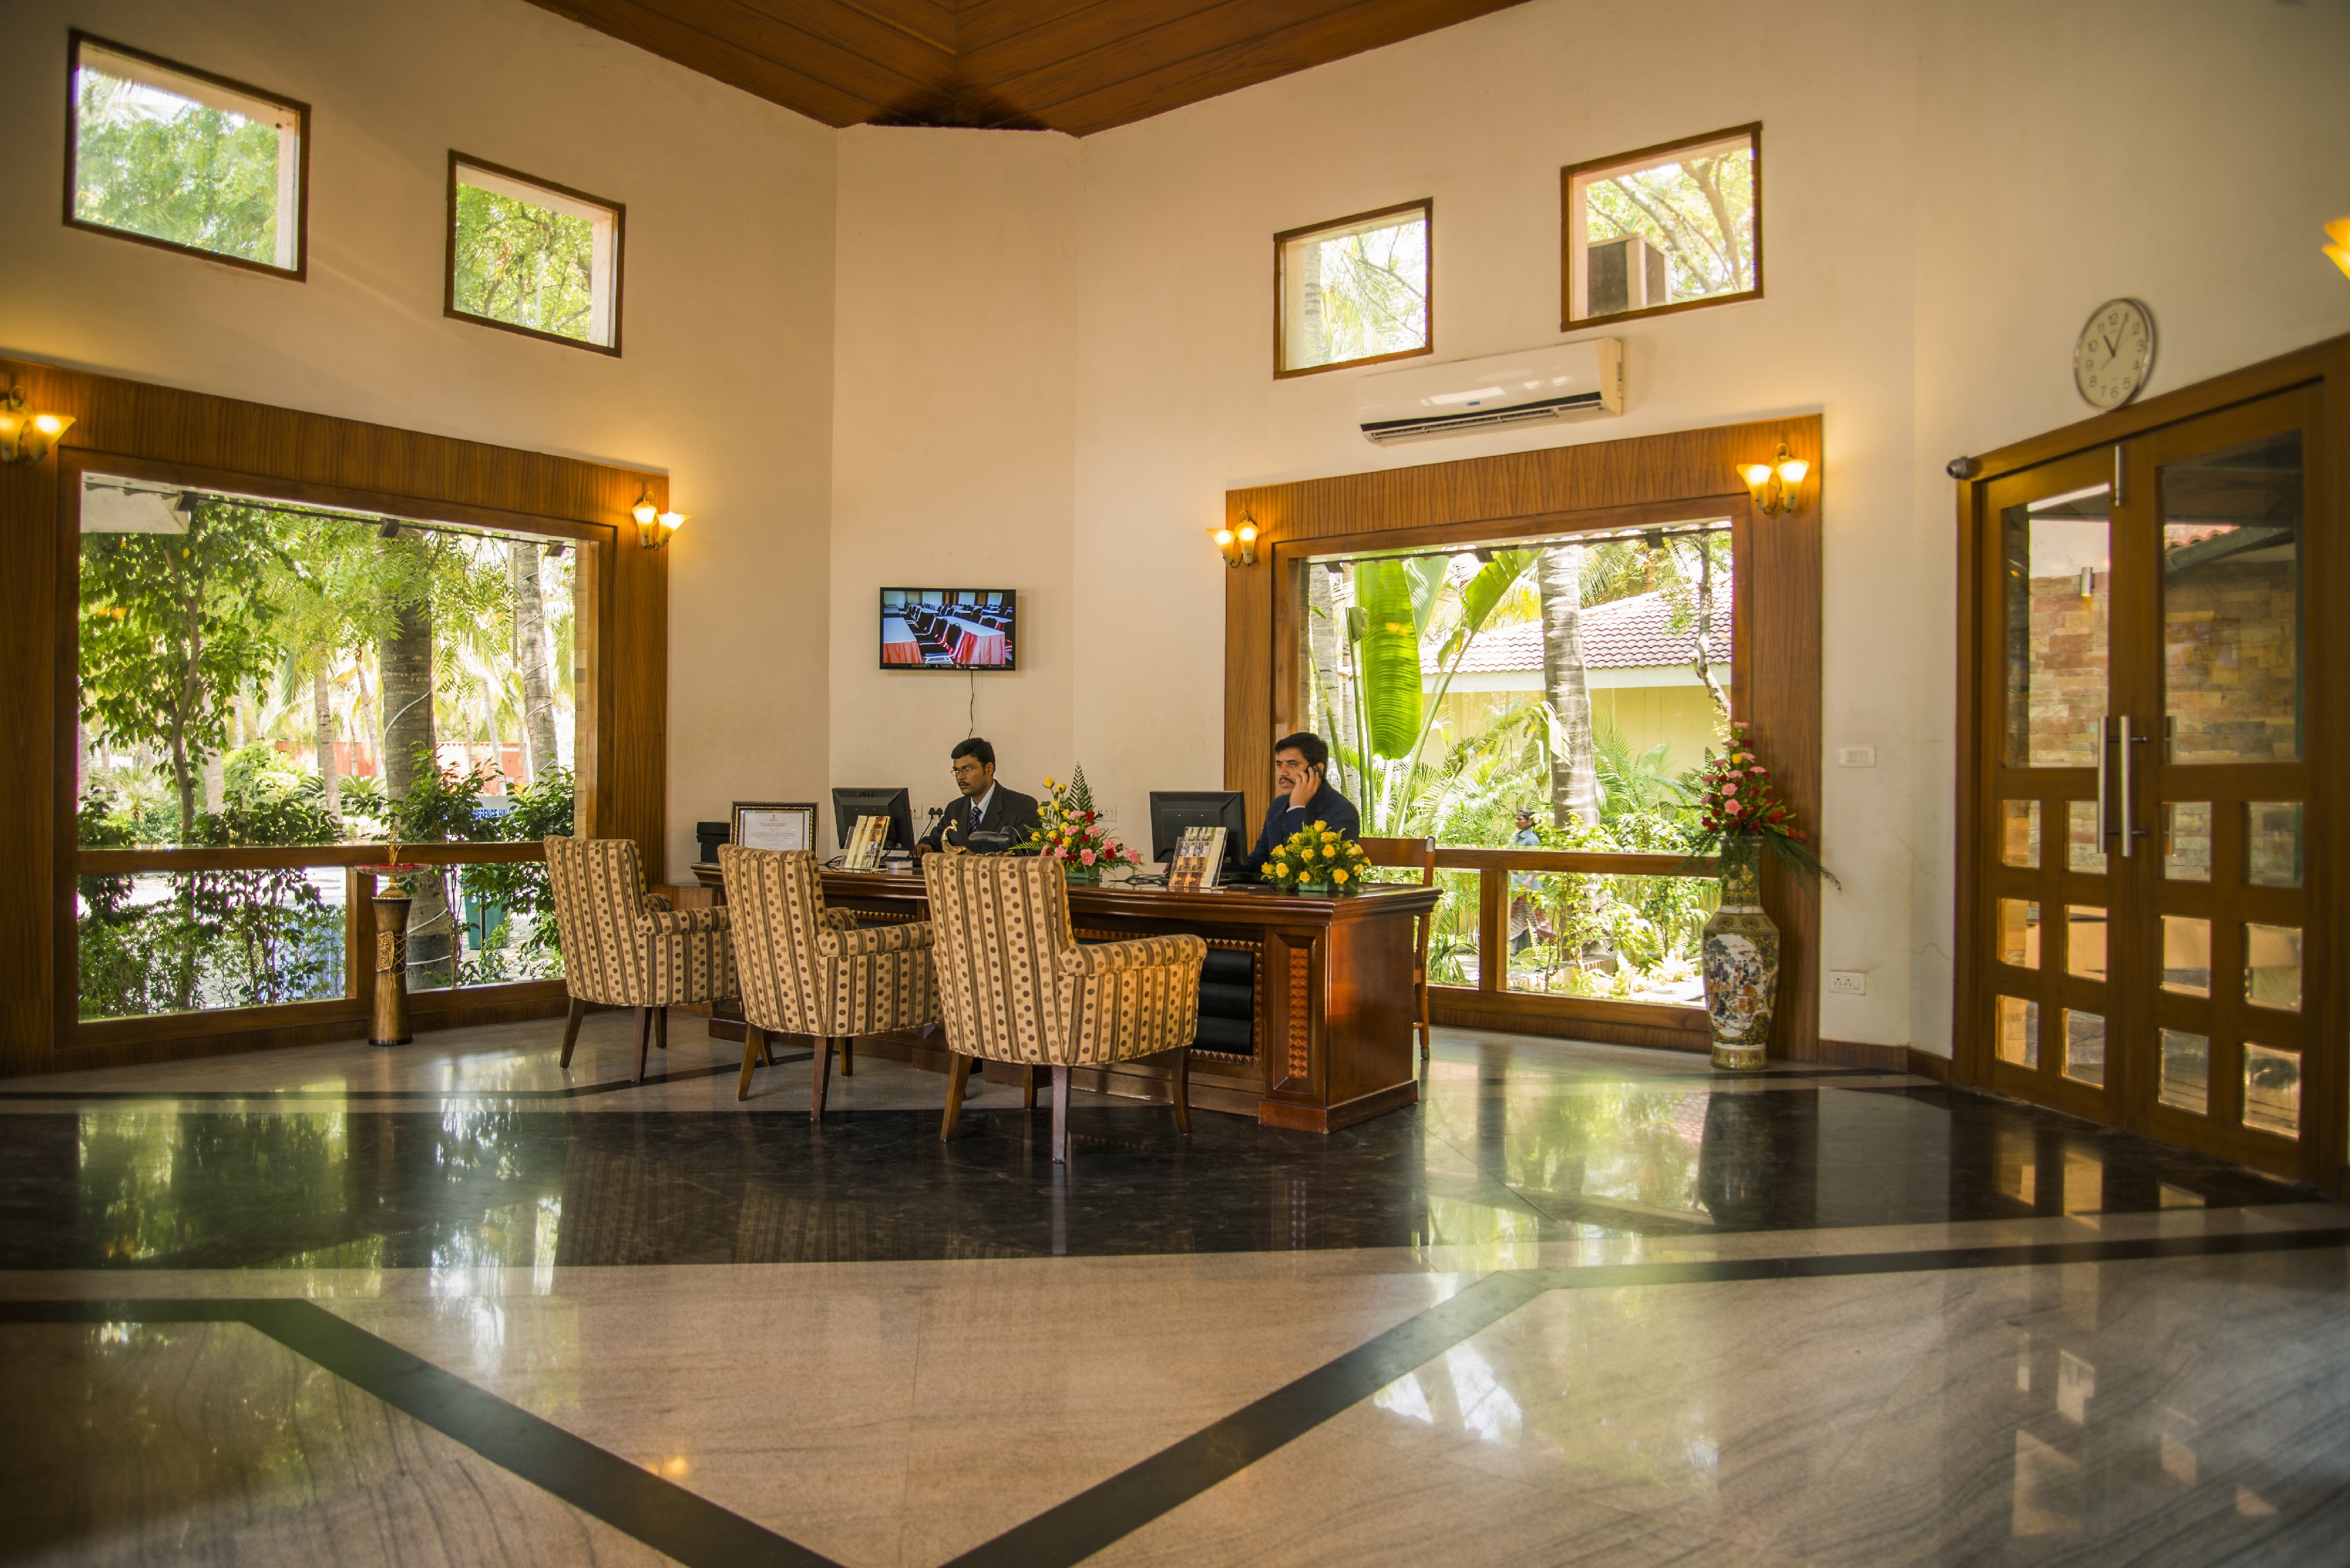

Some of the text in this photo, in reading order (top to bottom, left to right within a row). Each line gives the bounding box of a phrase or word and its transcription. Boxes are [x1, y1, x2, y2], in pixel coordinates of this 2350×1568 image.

[2108, 313, 2118, 326] 12
[2097, 322, 2105, 334] 11
[2132, 322, 2140, 335] 2
[2086, 339, 2098, 352] 10
[2136, 339, 2144, 352] 3
[2084, 359, 2094, 371] 9
[2132, 359, 2140, 370] 4
[2089, 375, 2097, 388] 8
[2123, 377, 2131, 389] 5
[2099, 385, 2106, 398] 7
[2110, 386, 2119, 399] 6
